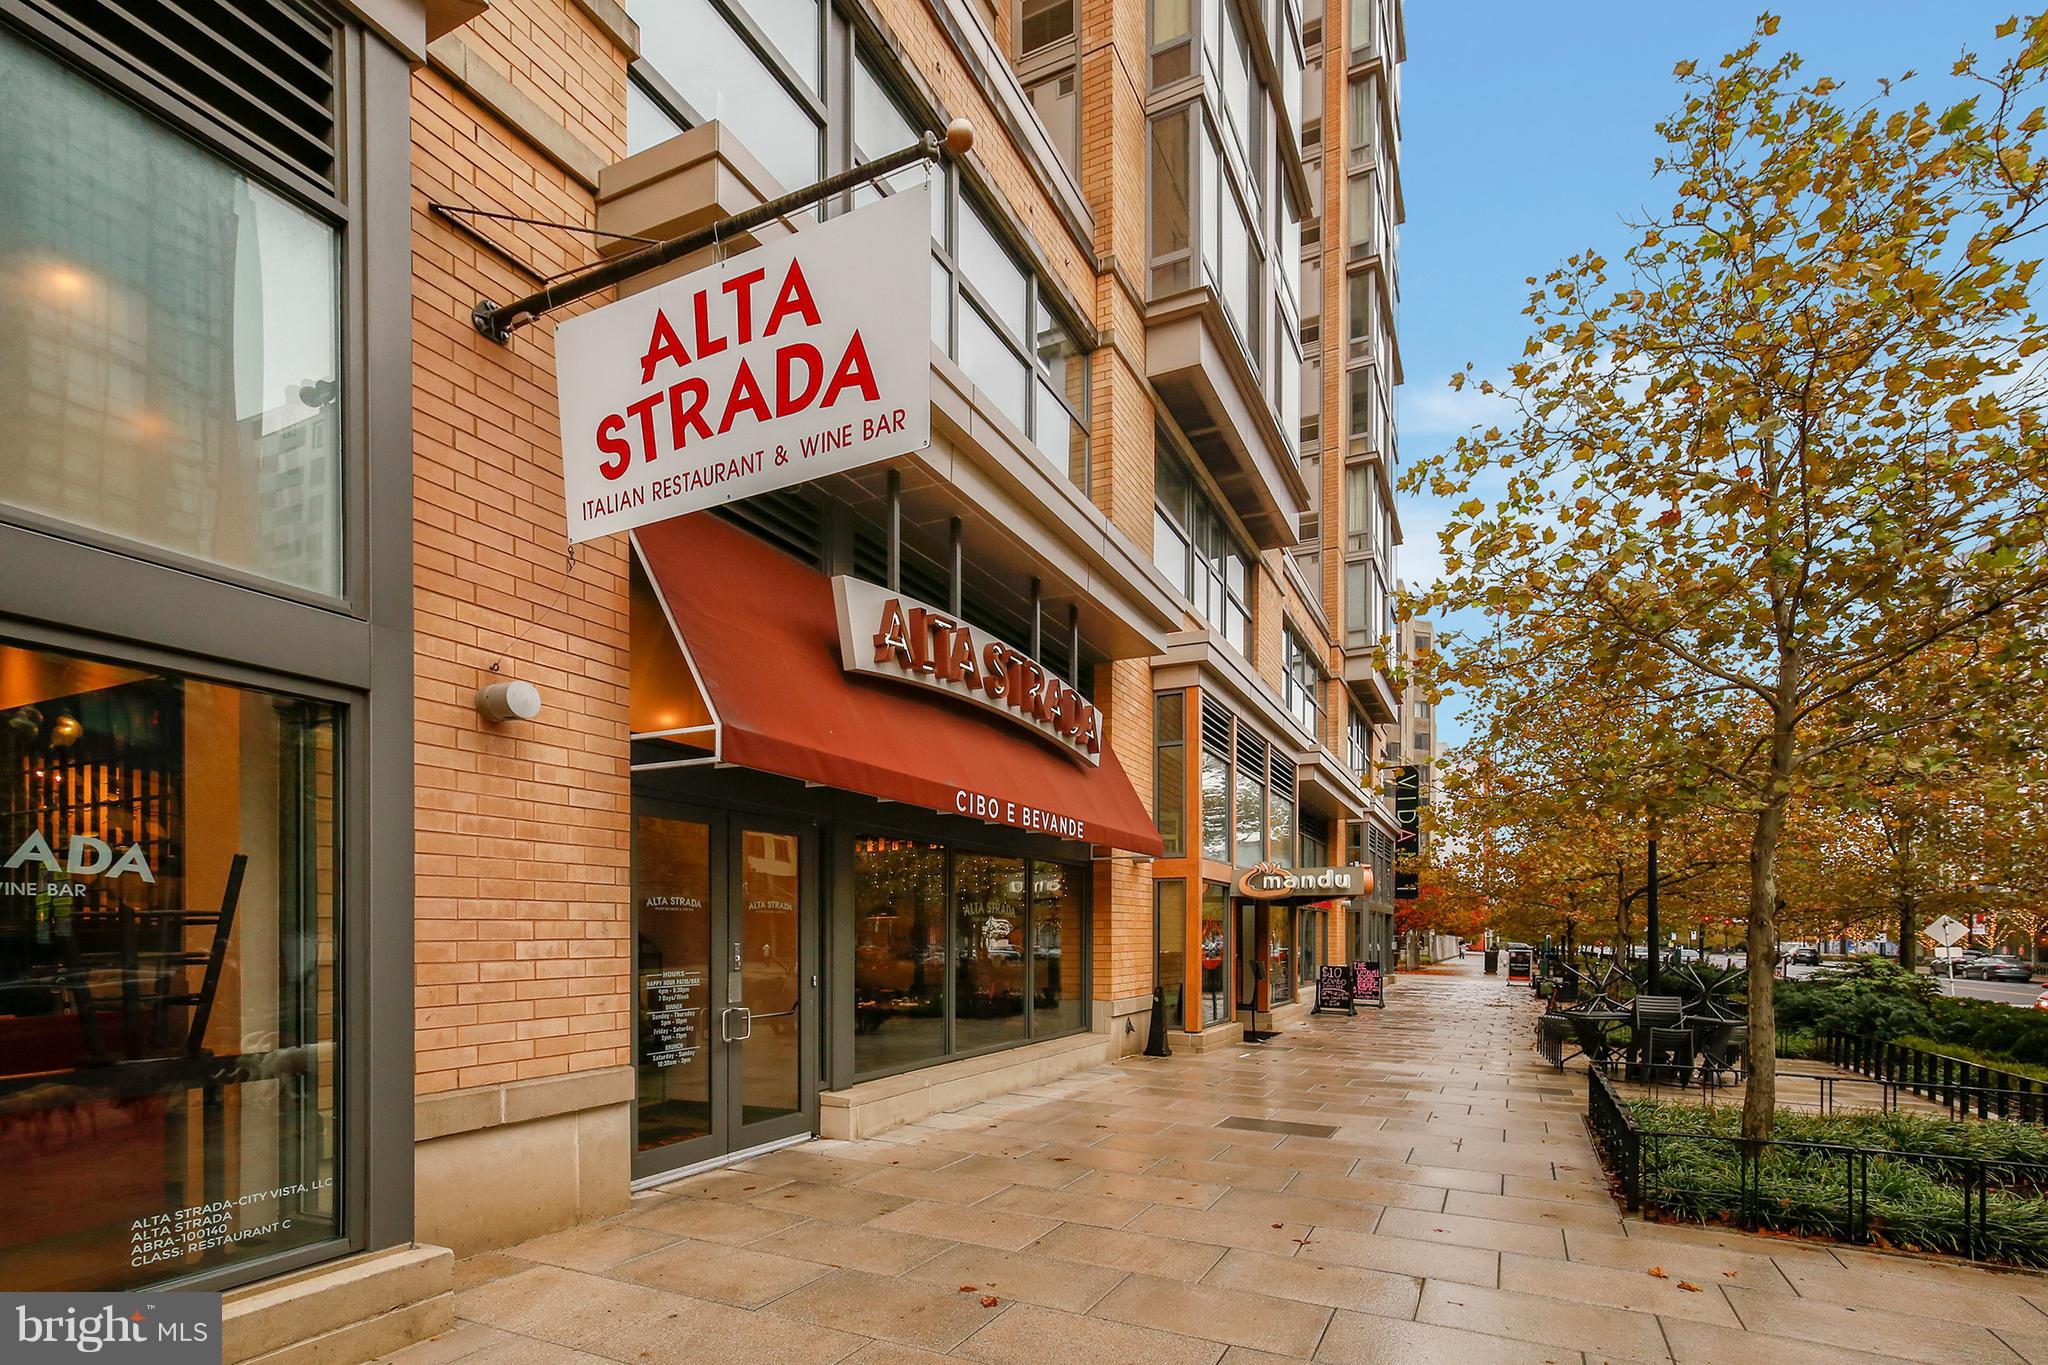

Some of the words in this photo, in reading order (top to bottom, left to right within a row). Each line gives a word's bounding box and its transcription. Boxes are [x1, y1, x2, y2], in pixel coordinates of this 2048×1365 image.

[641, 256, 822, 385] ALTA
[597, 328, 880, 480] STRADA
[582, 485, 645, 521] ITALIAN
[652, 450, 764, 501] RESTAURANT
[775, 445, 789, 467] &
[800, 424, 852, 459] WINE
[863, 408, 906, 441] BAR
[873, 599, 983, 690] ALTA
[983, 642, 1100, 754] STRADA
[956, 790, 999, 819] CIBO
[1007, 803, 1015, 823] E
[1023, 806, 1084, 839] BEVANDE
[1397, 774, 1417, 842] VIDA
[0, 828, 156, 884] ADA
[48, 882, 86, 897] BAR
[1263, 869, 1351, 889] mandu
[647, 896, 668, 907] ALTA
[670, 896, 701, 908] STRADA
[749, 901, 766, 911] ALTA
[767, 900, 792, 911] STRADA
[963, 901, 985, 916] ALTA
[646, 979, 663, 987] HAPPY
[662, 970, 685, 978] HOURS
[652, 1012, 670, 1021] Sunday
[674, 1010, 696, 1019] Thursday
[653, 1027, 669, 1036] Friday
[673, 1024, 694, 1033] Saturday
[652, 1053, 674, 1062] Saturday
[679, 1049, 696, 1058] Sunday
[665, 1042, 684, 1051] BRUNCH
[131, 1214, 171, 1230] ALTA
[174, 1191, 267, 1221] STRADA-CITY
[270, 1183, 309, 1198] VISTA,
[312, 1177, 333, 1190] LLC
[130, 1227, 171, 1243] ALTA
[174, 1212, 232, 1233] STRADA
[130, 1224, 227, 1256] ABRA-100140
[131, 1248, 183, 1267] CLASS:
[188, 1222, 279, 1253] RESTAURANT
[282, 1219, 292, 1229] C
